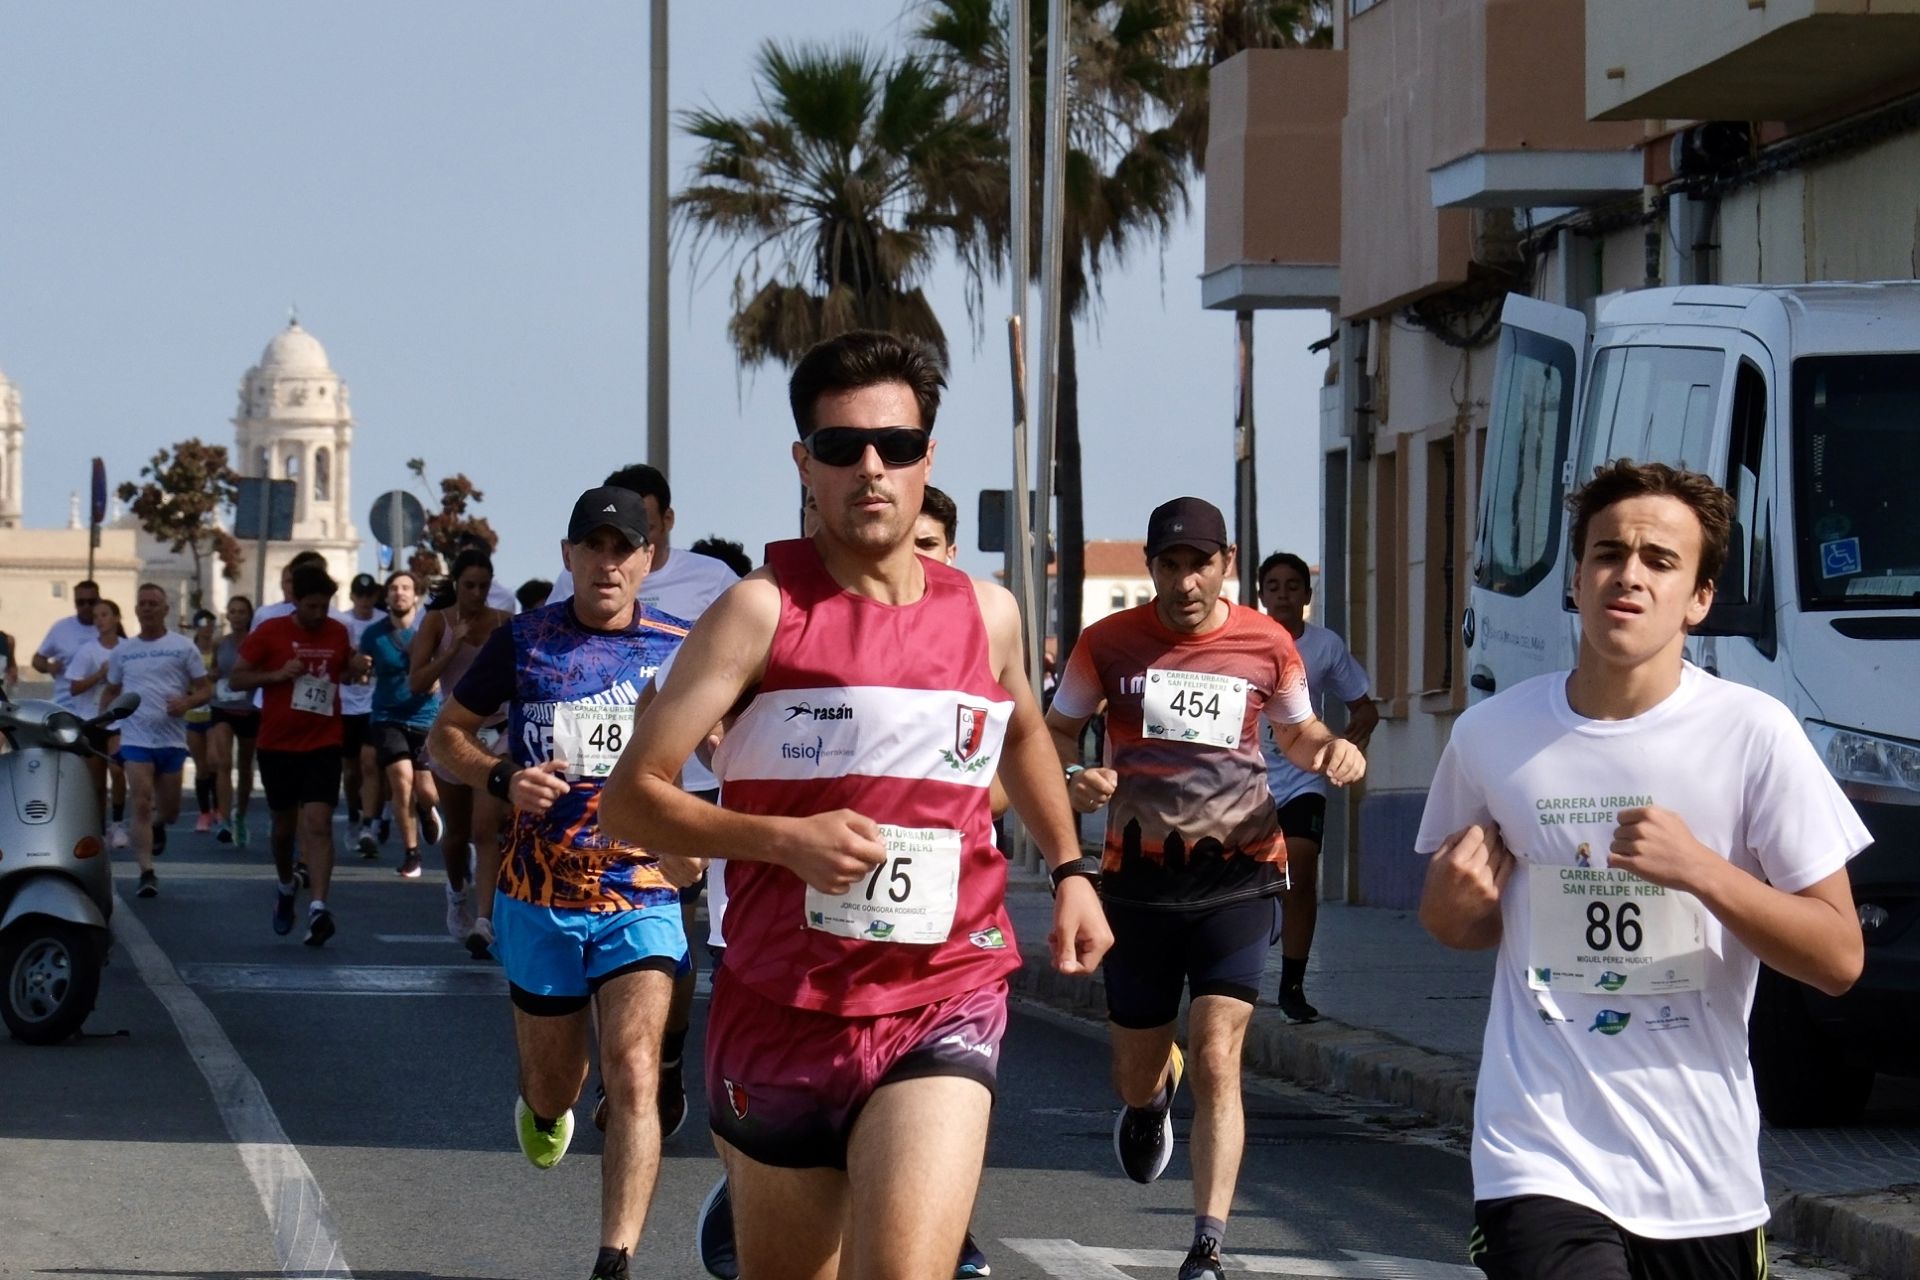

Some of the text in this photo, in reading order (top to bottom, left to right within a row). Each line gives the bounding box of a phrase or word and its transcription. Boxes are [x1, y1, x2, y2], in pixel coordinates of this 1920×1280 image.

[813, 703, 853, 721] rasán
[1170, 689, 1221, 720] 454
[588, 723, 622, 753] 48
[1536, 795, 1654, 811] CARRERA URBANA
[1540, 811, 1613, 826] SAN FELIPE
[887, 841, 907, 852] IPE
[865, 857, 912, 903] 75
[1560, 868, 1614, 882] CARRERA
[1563, 883, 1665, 897] SAN FELIPE NERI
[841, 903, 861, 912] JORGE
[1586, 901, 1643, 952] 86
[1577, 955, 1602, 964] MIGUEL
[1625, 956, 1654, 965] HUGUET
